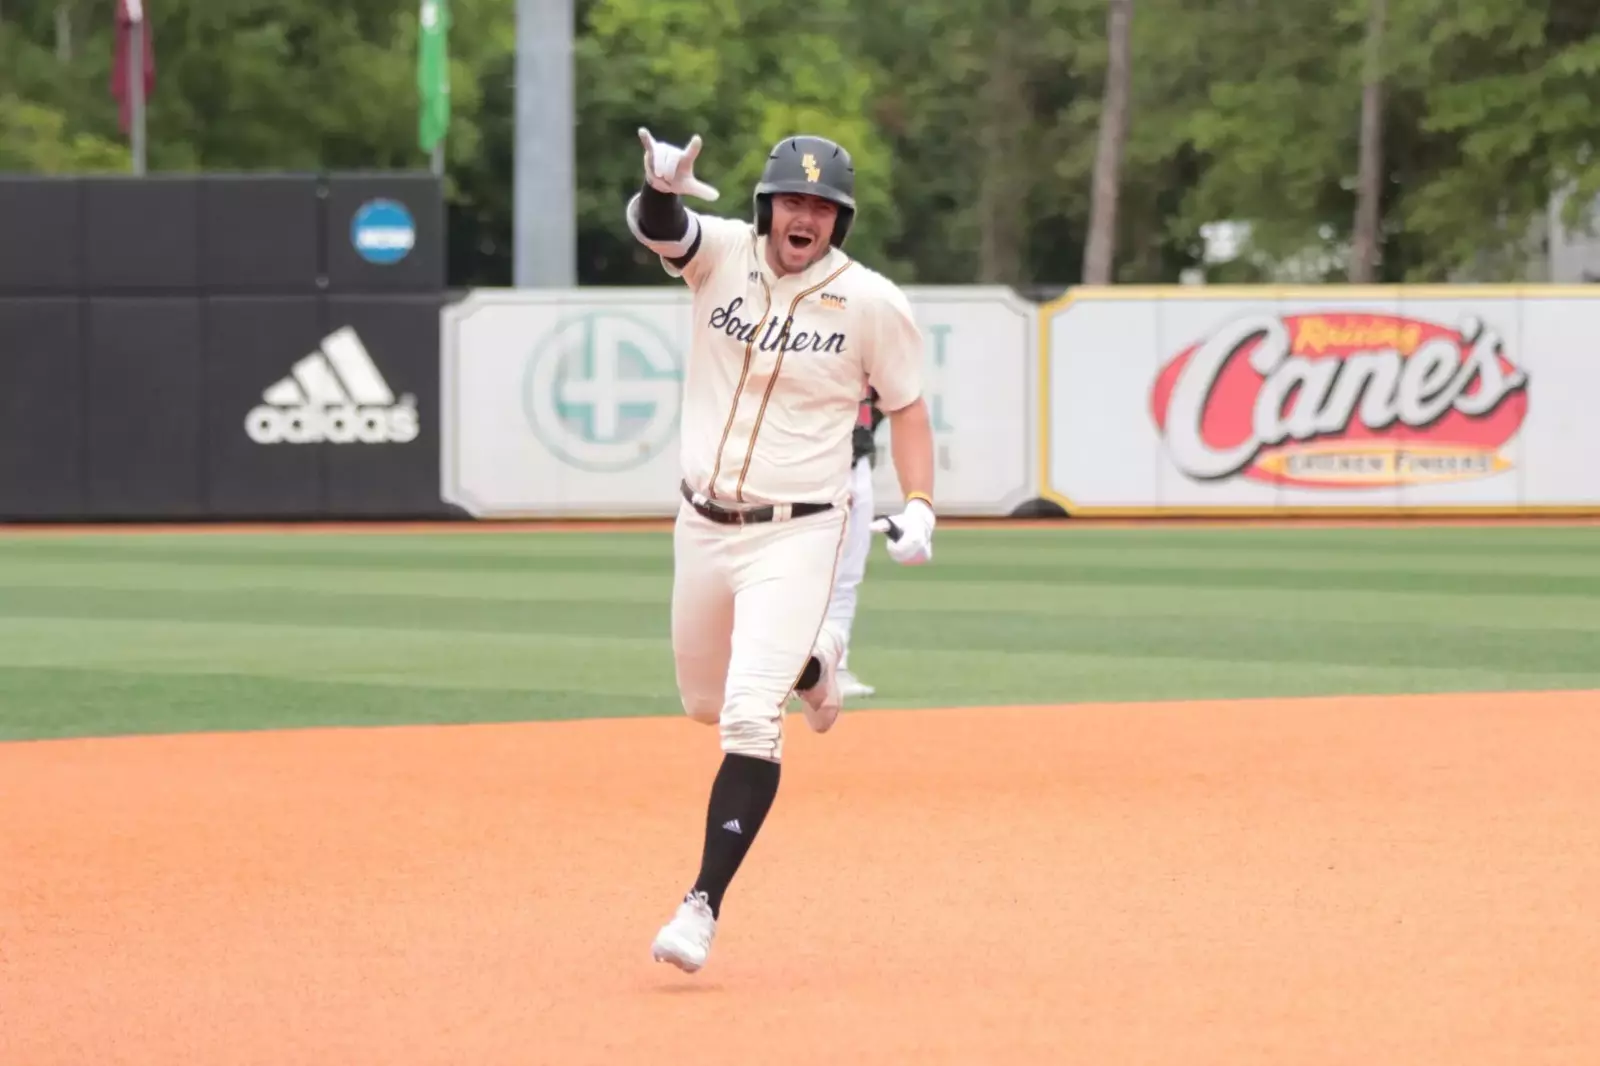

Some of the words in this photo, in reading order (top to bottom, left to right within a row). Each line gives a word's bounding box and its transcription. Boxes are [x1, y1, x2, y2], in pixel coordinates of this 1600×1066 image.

[708, 296, 847, 354] Southern
[244, 399, 420, 444] adidas
[1164, 312, 1529, 484] Cane's
